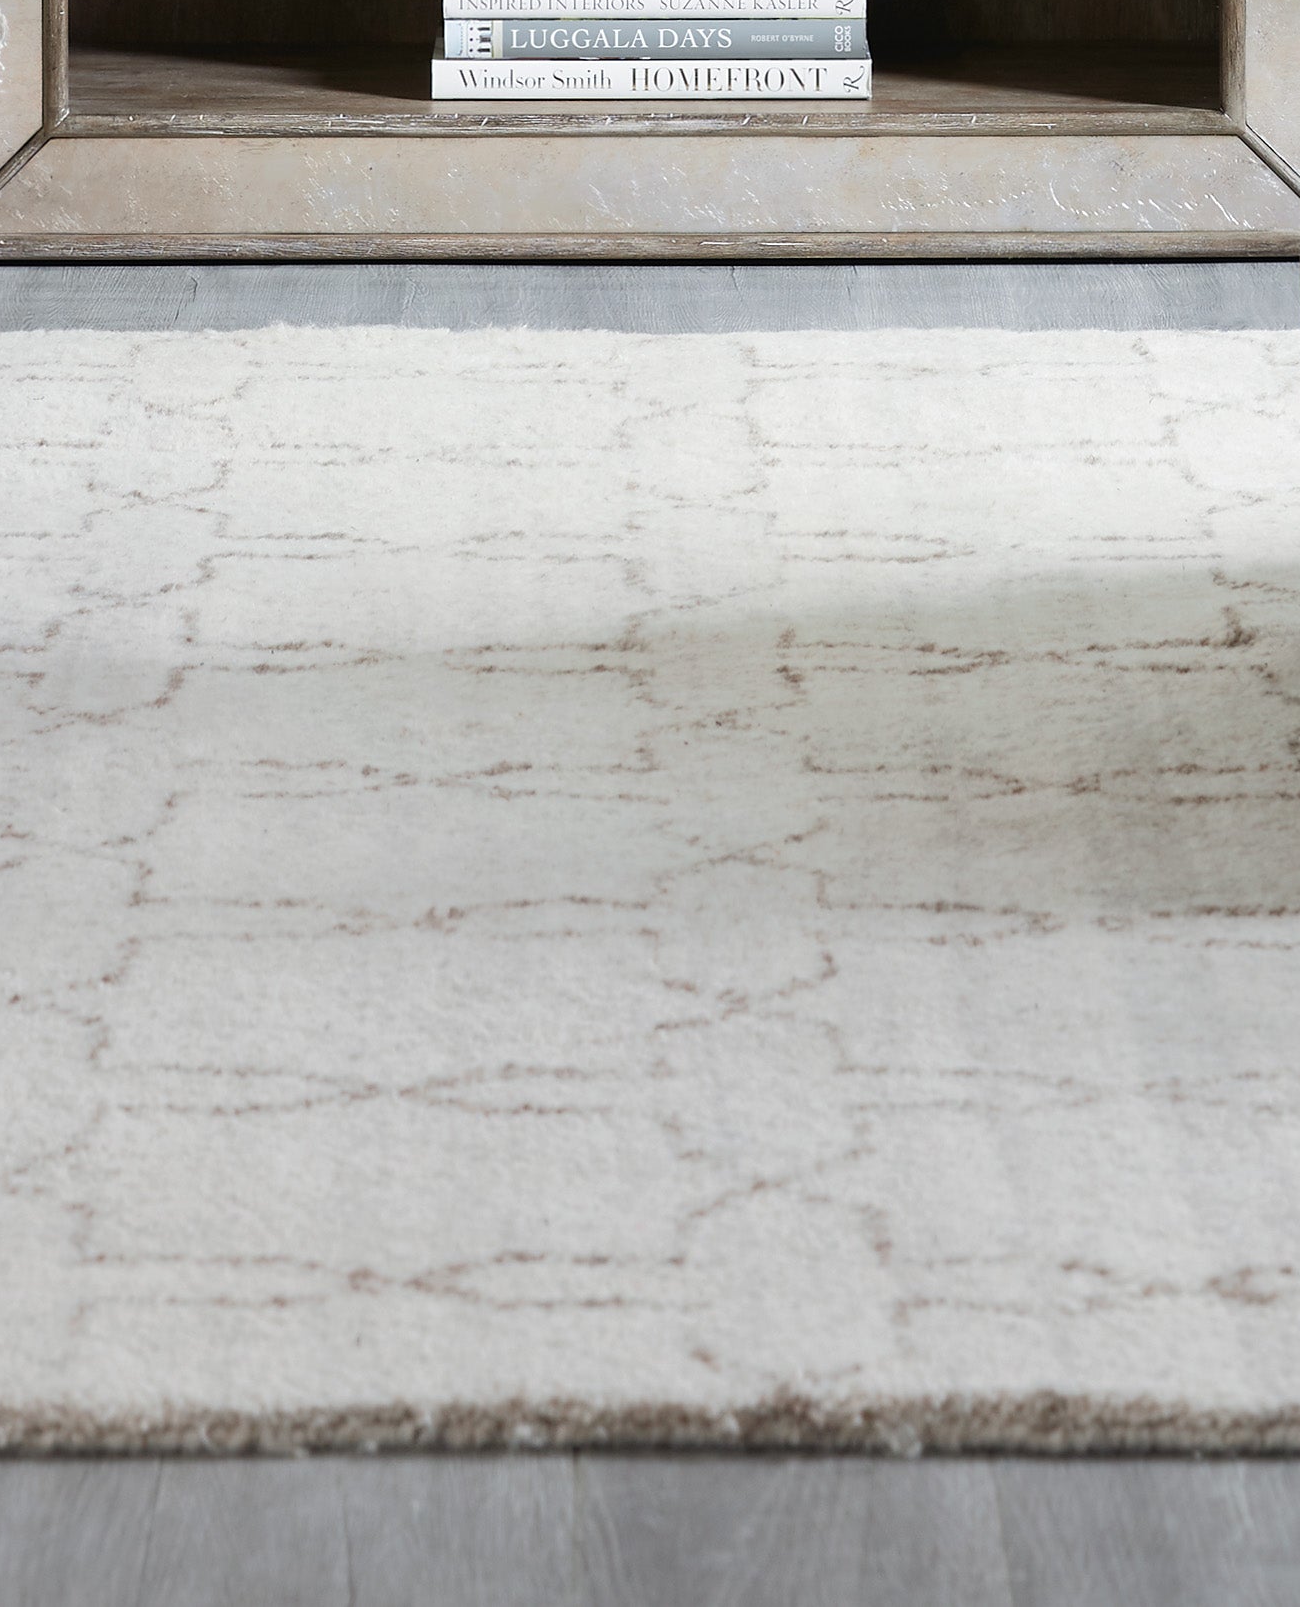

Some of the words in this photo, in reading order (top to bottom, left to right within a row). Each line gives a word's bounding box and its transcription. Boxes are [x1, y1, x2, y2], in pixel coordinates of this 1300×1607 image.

[510, 29, 648, 49] LUGGALA
[658, 28, 732, 48] DAYS
[835, 26, 843, 52] CICO
[459, 69, 546, 91] Windsor
[552, 68, 612, 90] Smith
[631, 67, 828, 92] HOMEFRONT
